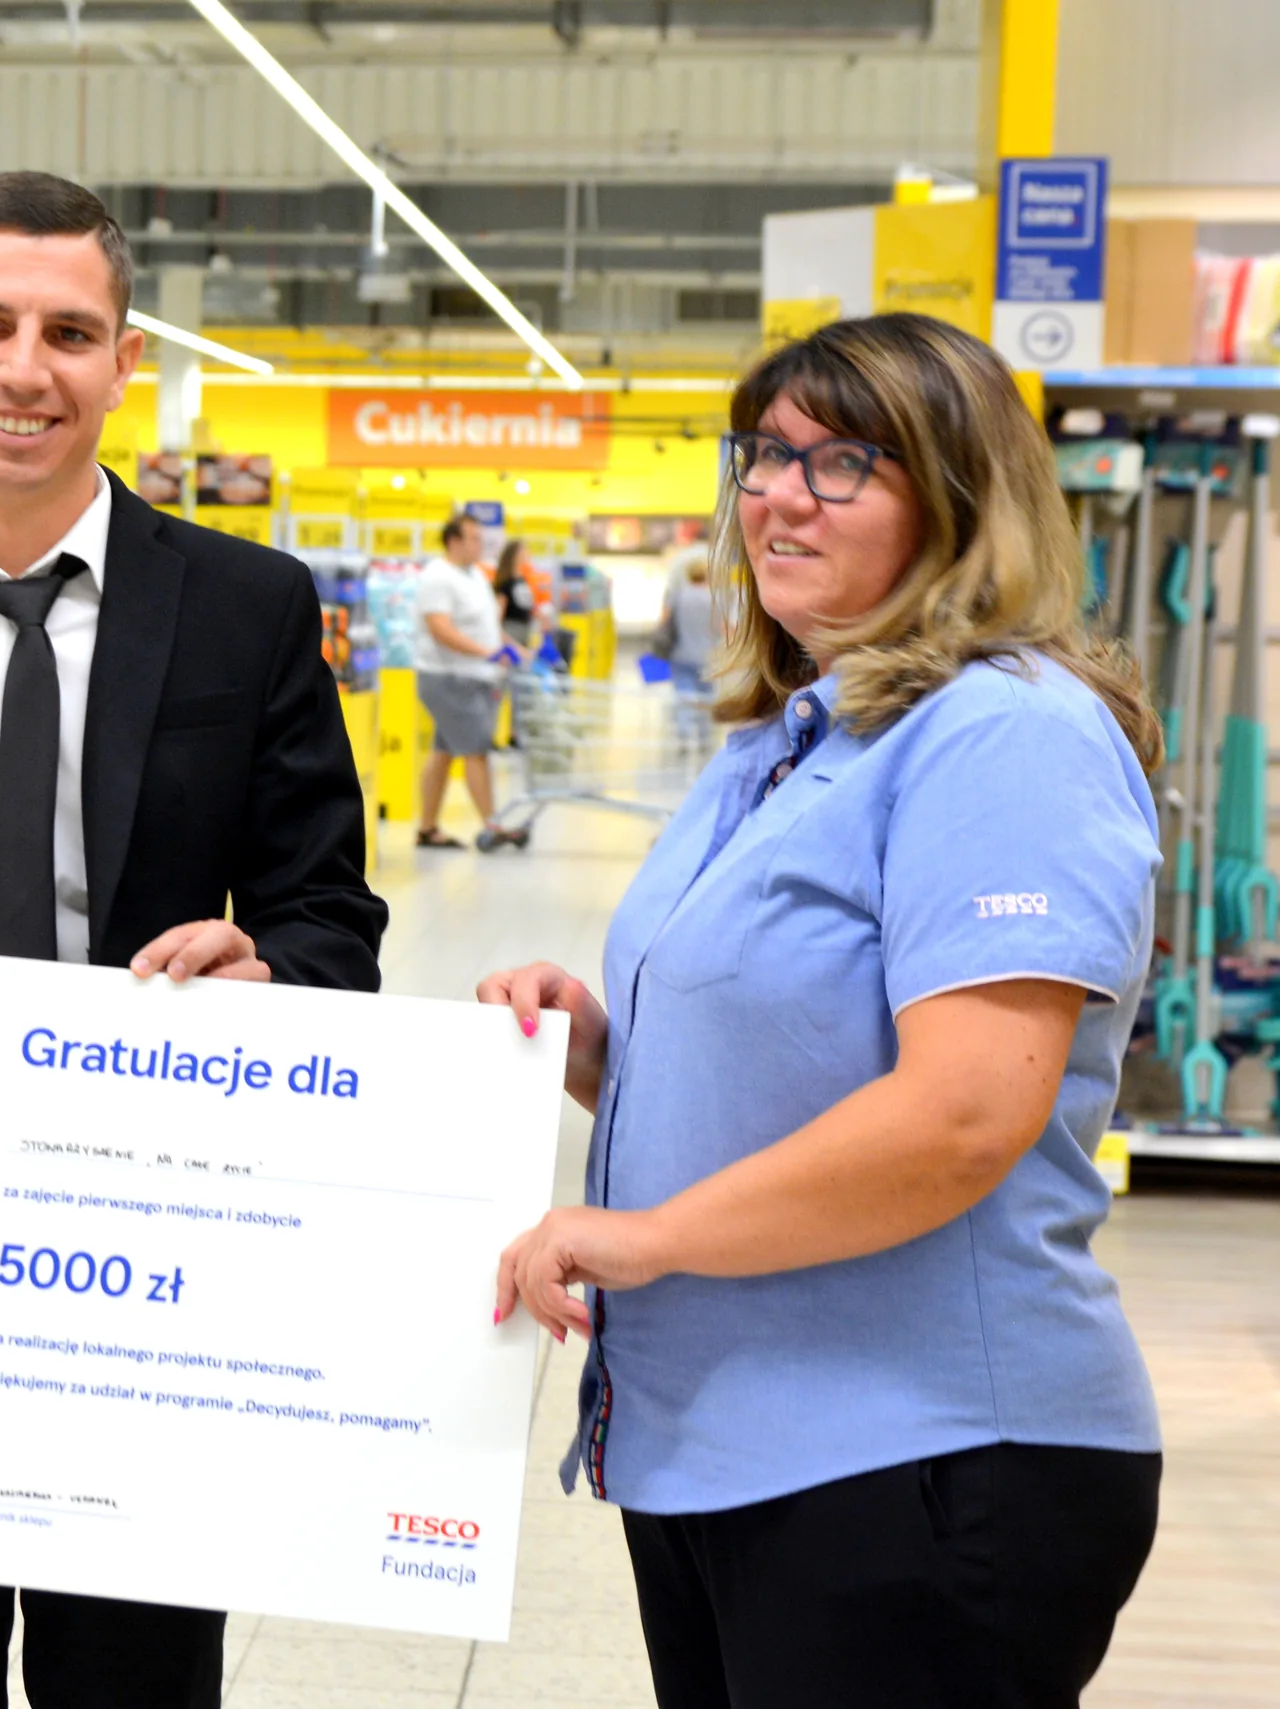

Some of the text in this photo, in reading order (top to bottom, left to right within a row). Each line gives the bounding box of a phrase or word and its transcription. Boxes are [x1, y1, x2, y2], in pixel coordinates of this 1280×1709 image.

[354, 400, 583, 447] Cukiernia
[972, 892, 1049, 918] TESCO
[21, 1027, 360, 1099] Gratulacje dla
[3, 1186, 19, 1198] za
[23, 1187, 75, 1206] zajęcie
[78, 1191, 163, 1216] pierwszego
[166, 1202, 224, 1221] miejsca
[236, 1208, 303, 1230] zdobycie
[146, 1266, 185, 1304] zł
[8, 1333, 79, 1356] realizację
[83, 1339, 155, 1364] lokalnego
[158, 1349, 222, 1370] projektu
[226, 1357, 326, 1382] społecznego.
[70, 1381, 87, 1395] za
[90, 1382, 136, 1400] udział
[139, 1389, 153, 1402] w
[155, 1390, 234, 1411] programie
[386, 1511, 481, 1540] TESCO
[381, 1553, 477, 1588] Fundacja
